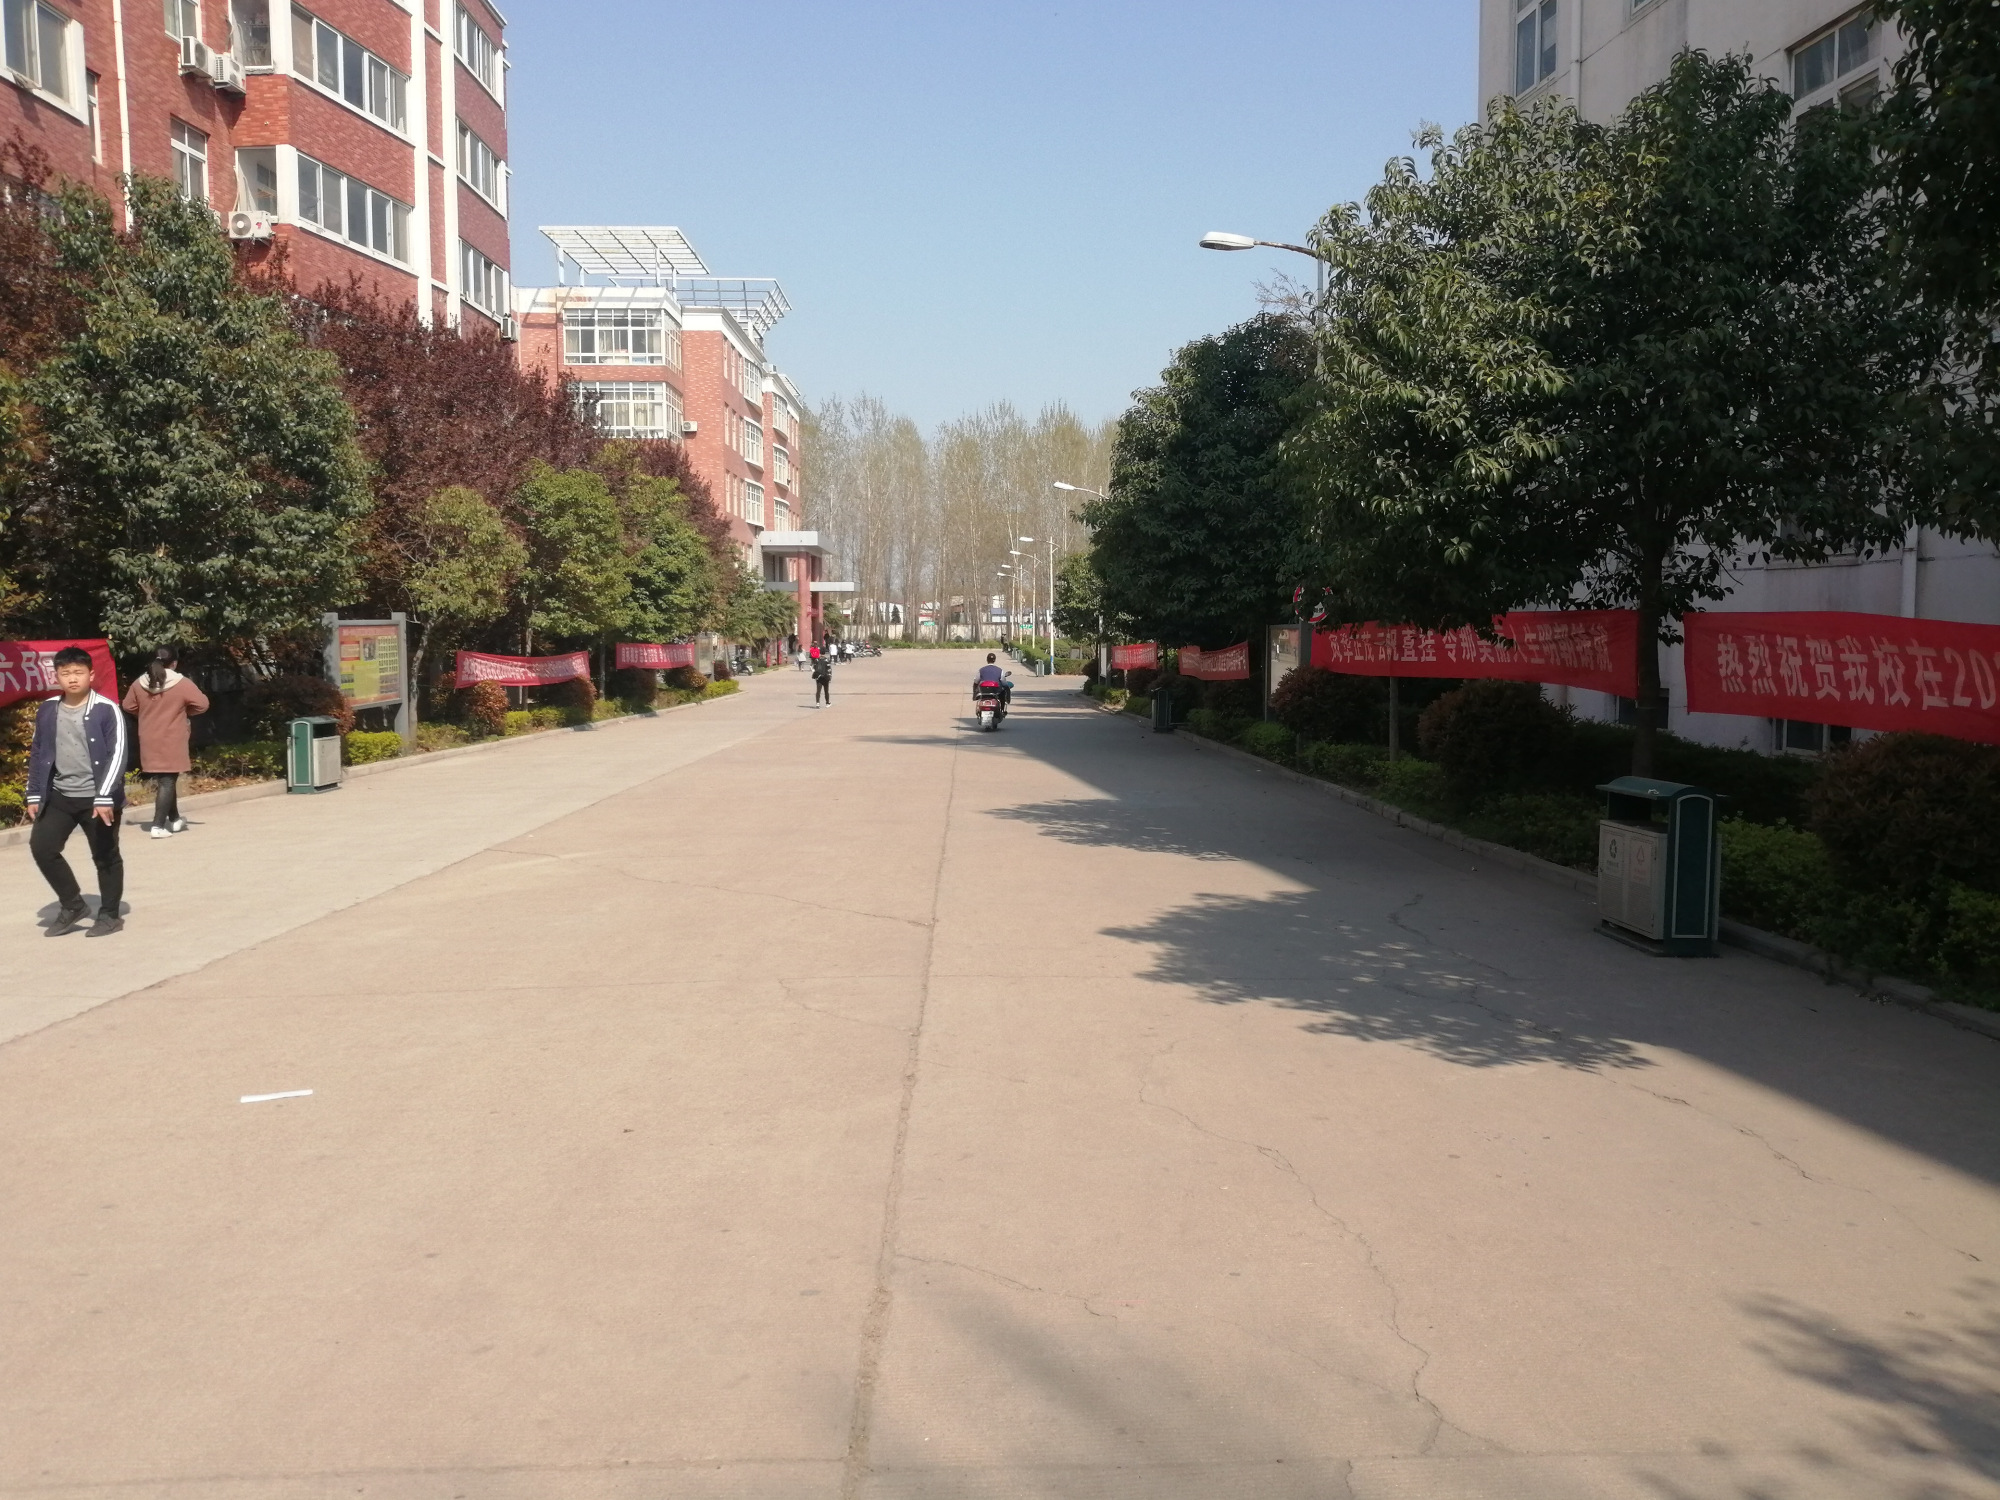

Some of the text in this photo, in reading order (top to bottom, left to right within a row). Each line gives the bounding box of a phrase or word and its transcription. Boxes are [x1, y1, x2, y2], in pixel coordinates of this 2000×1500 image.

[1716, 633, 2000, 711] 热烈祝贺我校在20
